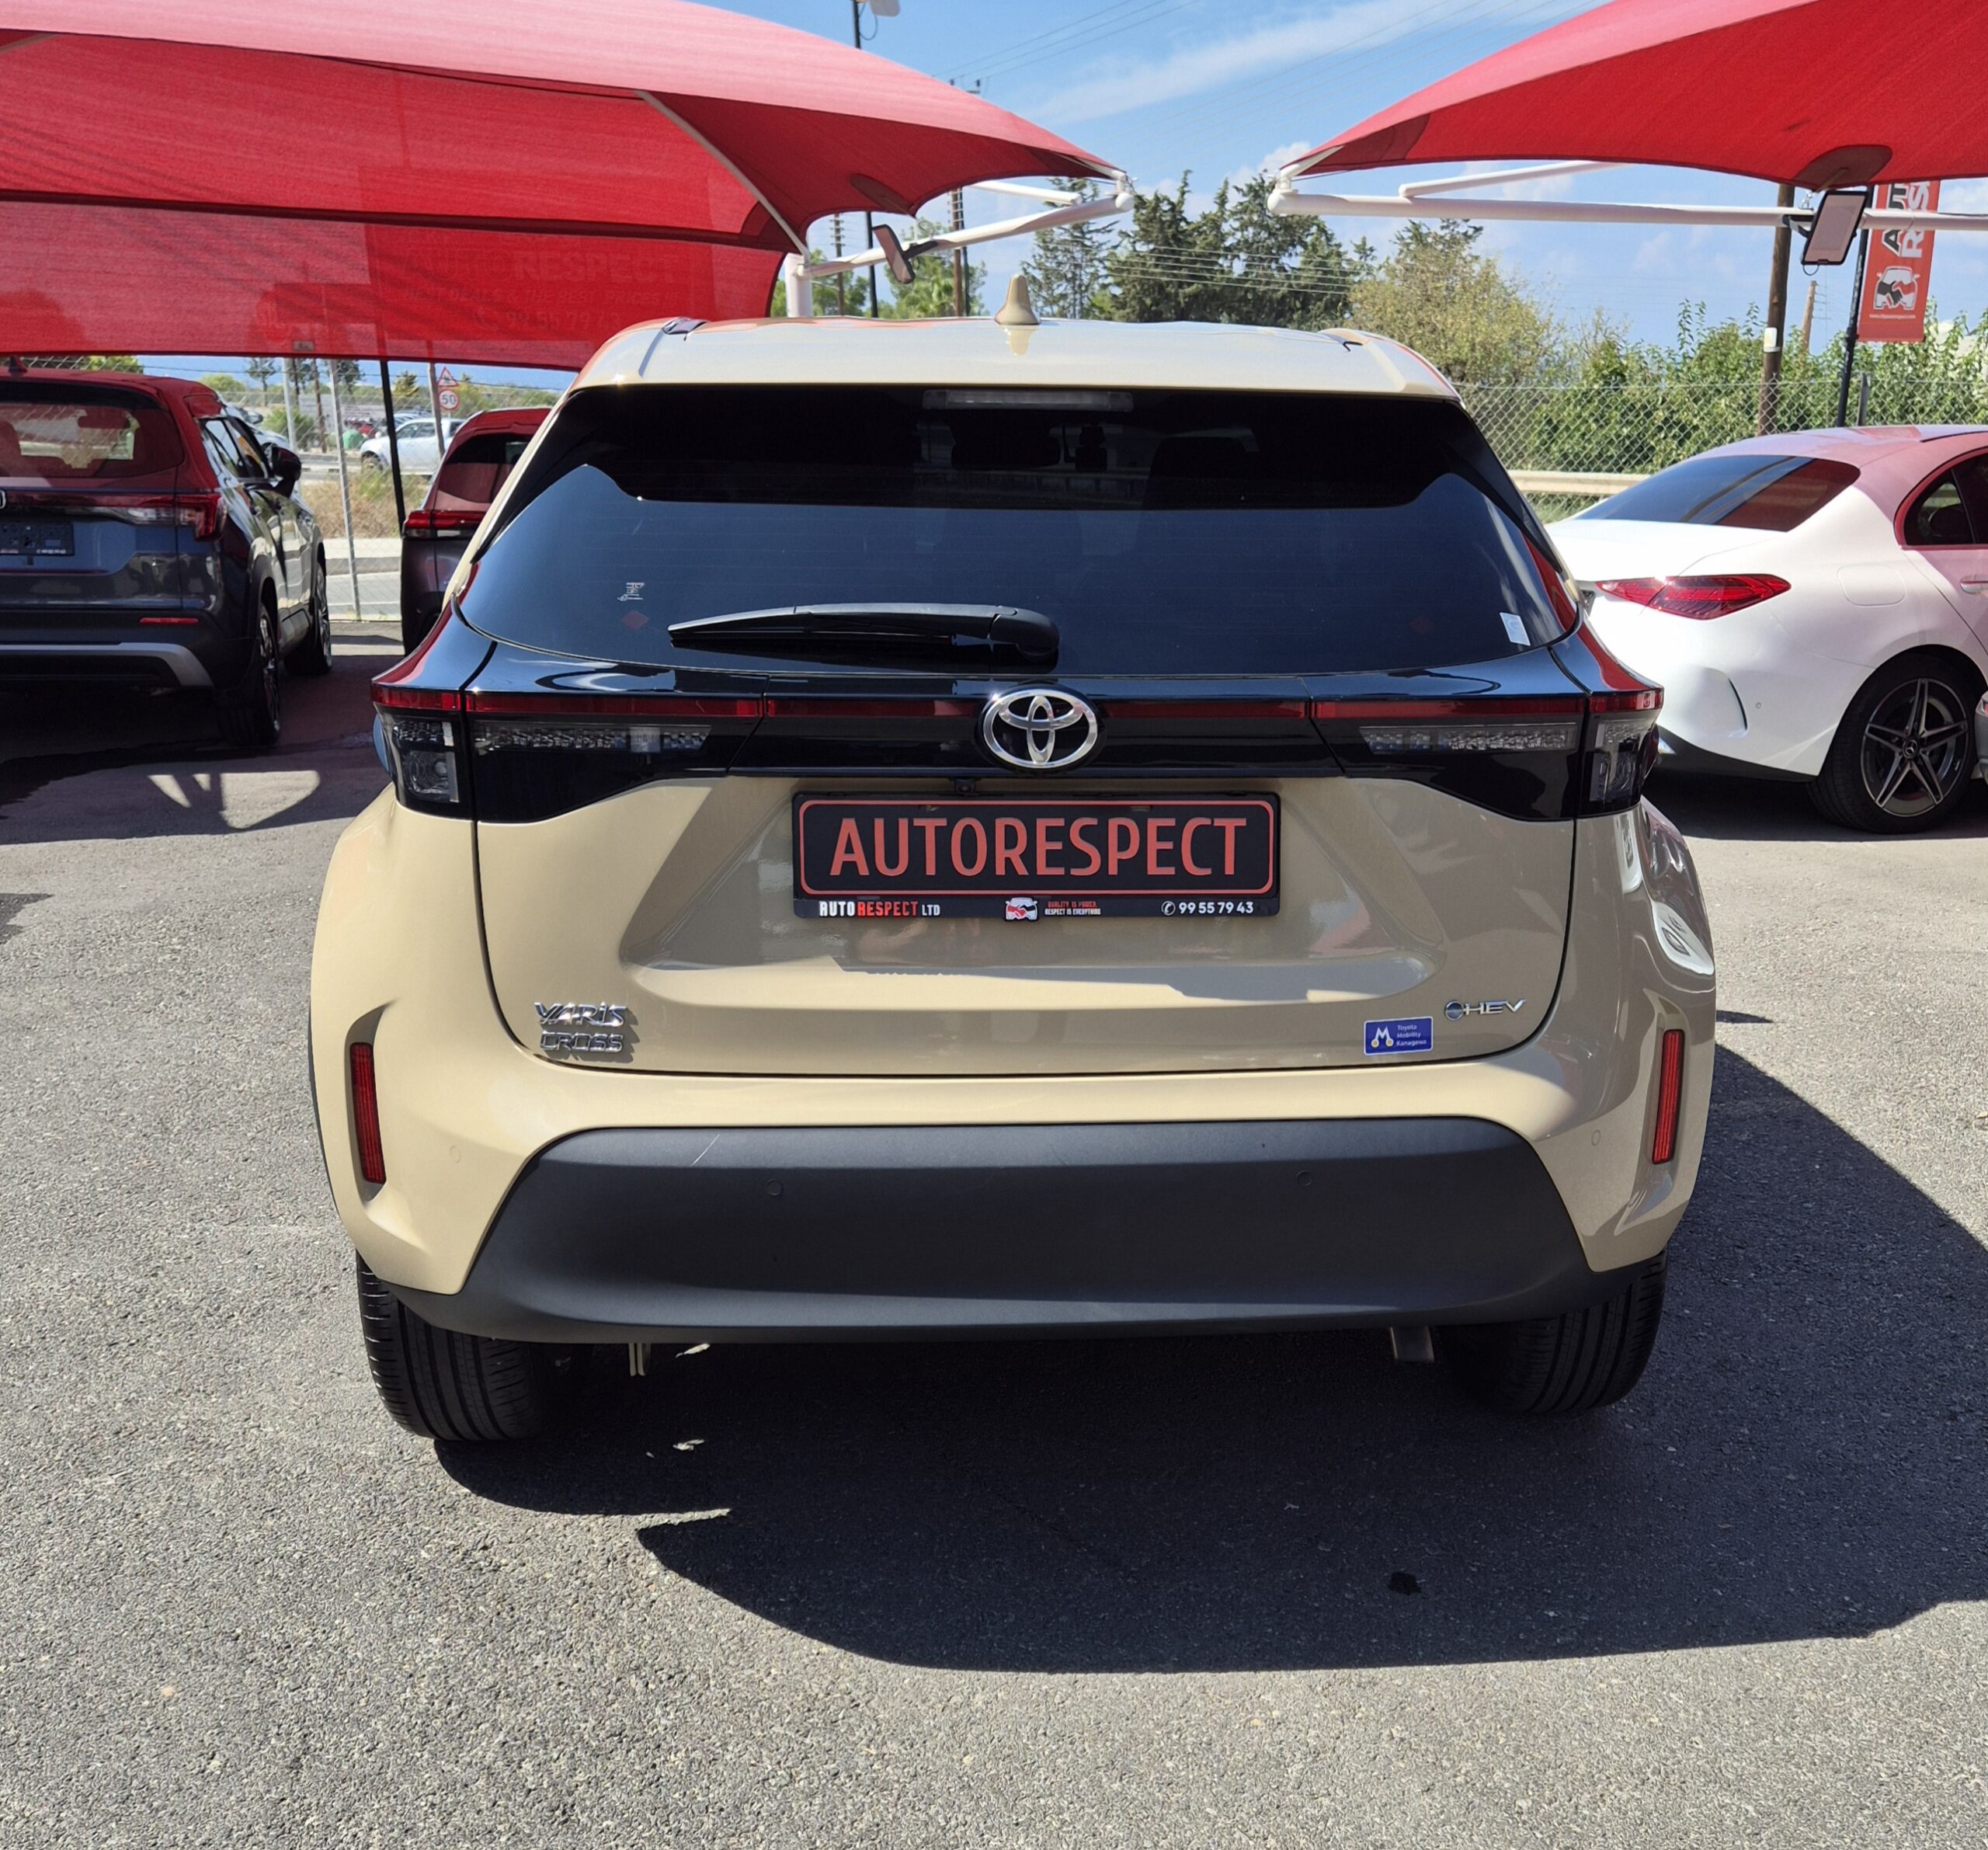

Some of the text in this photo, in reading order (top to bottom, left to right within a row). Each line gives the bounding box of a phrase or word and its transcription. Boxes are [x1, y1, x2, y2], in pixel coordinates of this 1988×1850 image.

[442, 394, 456, 405] 50
[829, 816, 1247, 876] AUTORESPECT
[921, 904, 940, 916] LTD
[1179, 902, 1253, 913] 99 55 79 43
[540, 1030, 624, 1052] CROSS
